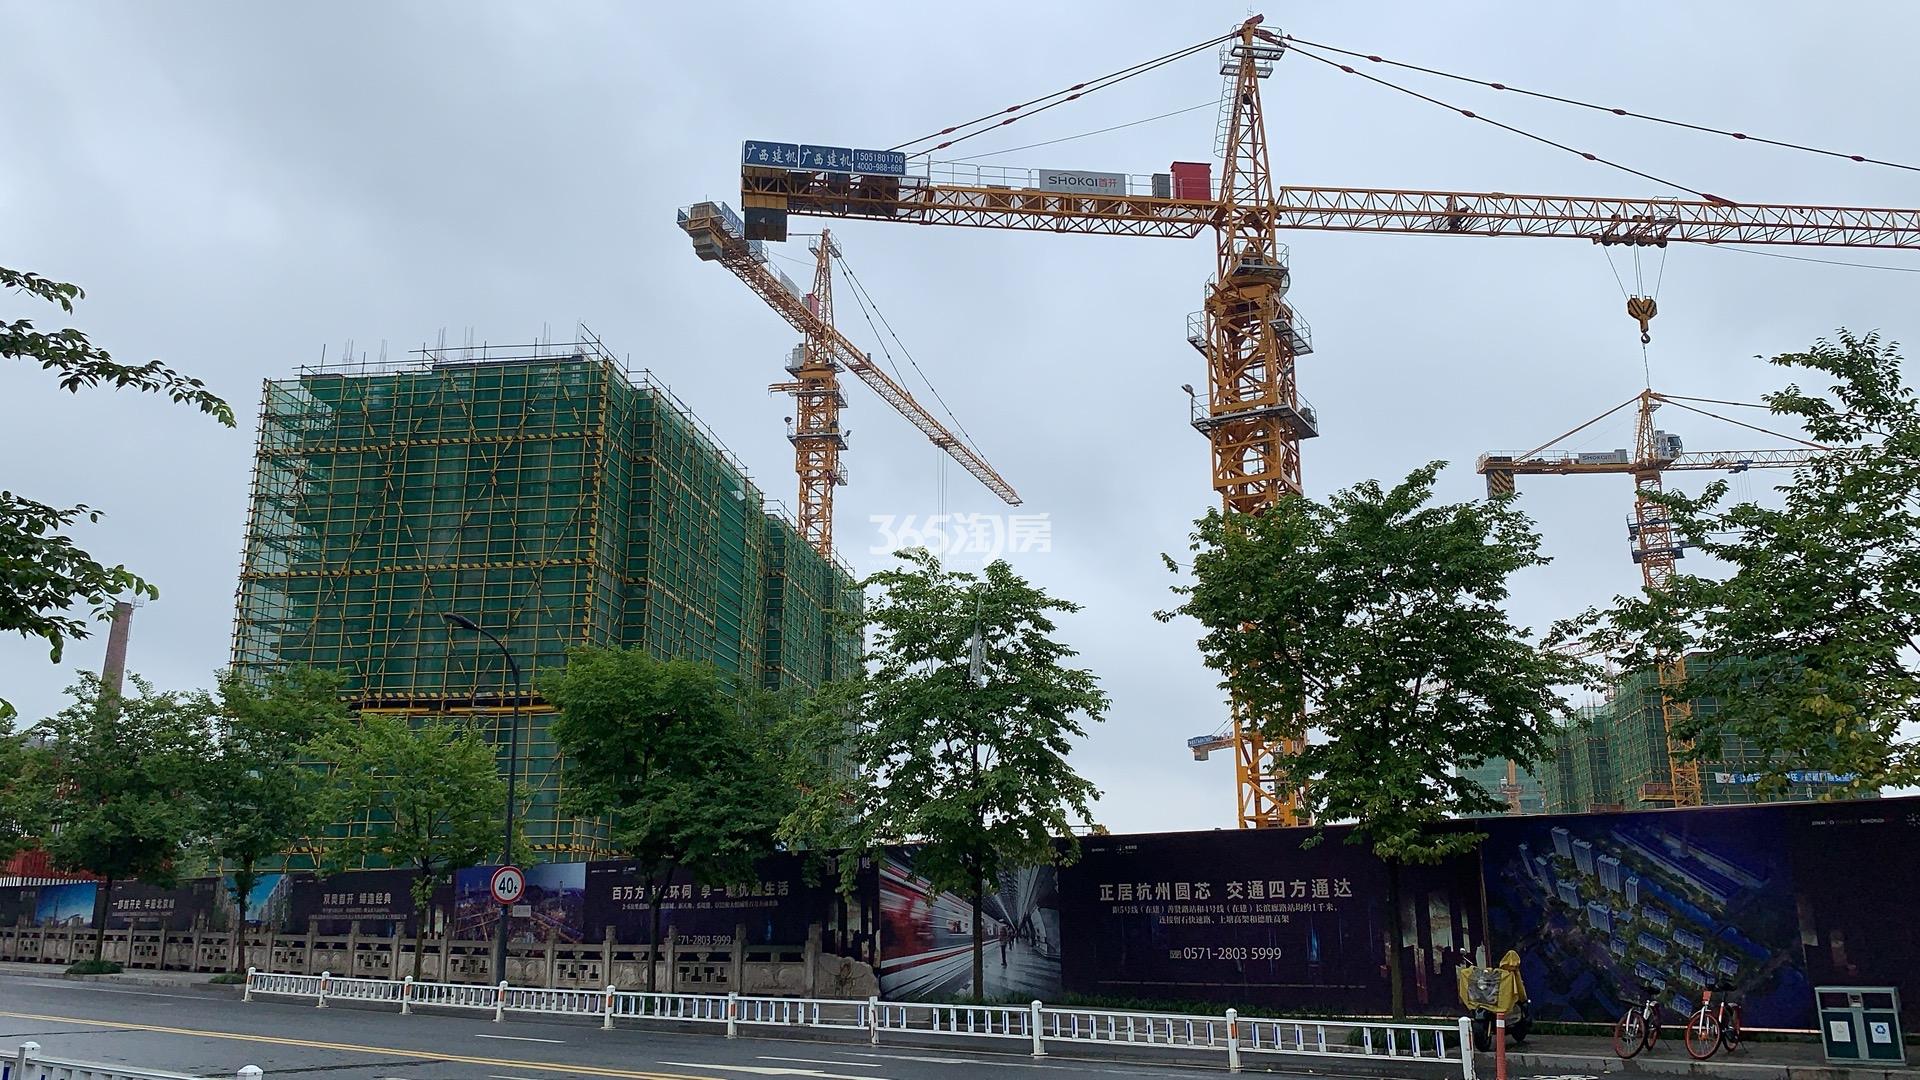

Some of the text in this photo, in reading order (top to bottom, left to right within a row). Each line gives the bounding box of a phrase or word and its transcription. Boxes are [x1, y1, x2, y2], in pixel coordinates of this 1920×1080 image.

[746, 143, 797, 163] 广西建机
[801, 149, 852, 167] 广西建机
[855, 152, 904, 164] 15051801700
[856, 162, 903, 173] 4000-988-668
[612, 884, 692, 900] 百万方环伺
[1099, 878, 1353, 902] 正居杭州圆芯 交通四方通达
[678, 935, 731, 945] 71-2803 5999
[1183, 947, 1247, 960] 0571-2803
[1251, 946, 1282, 960] 5999
